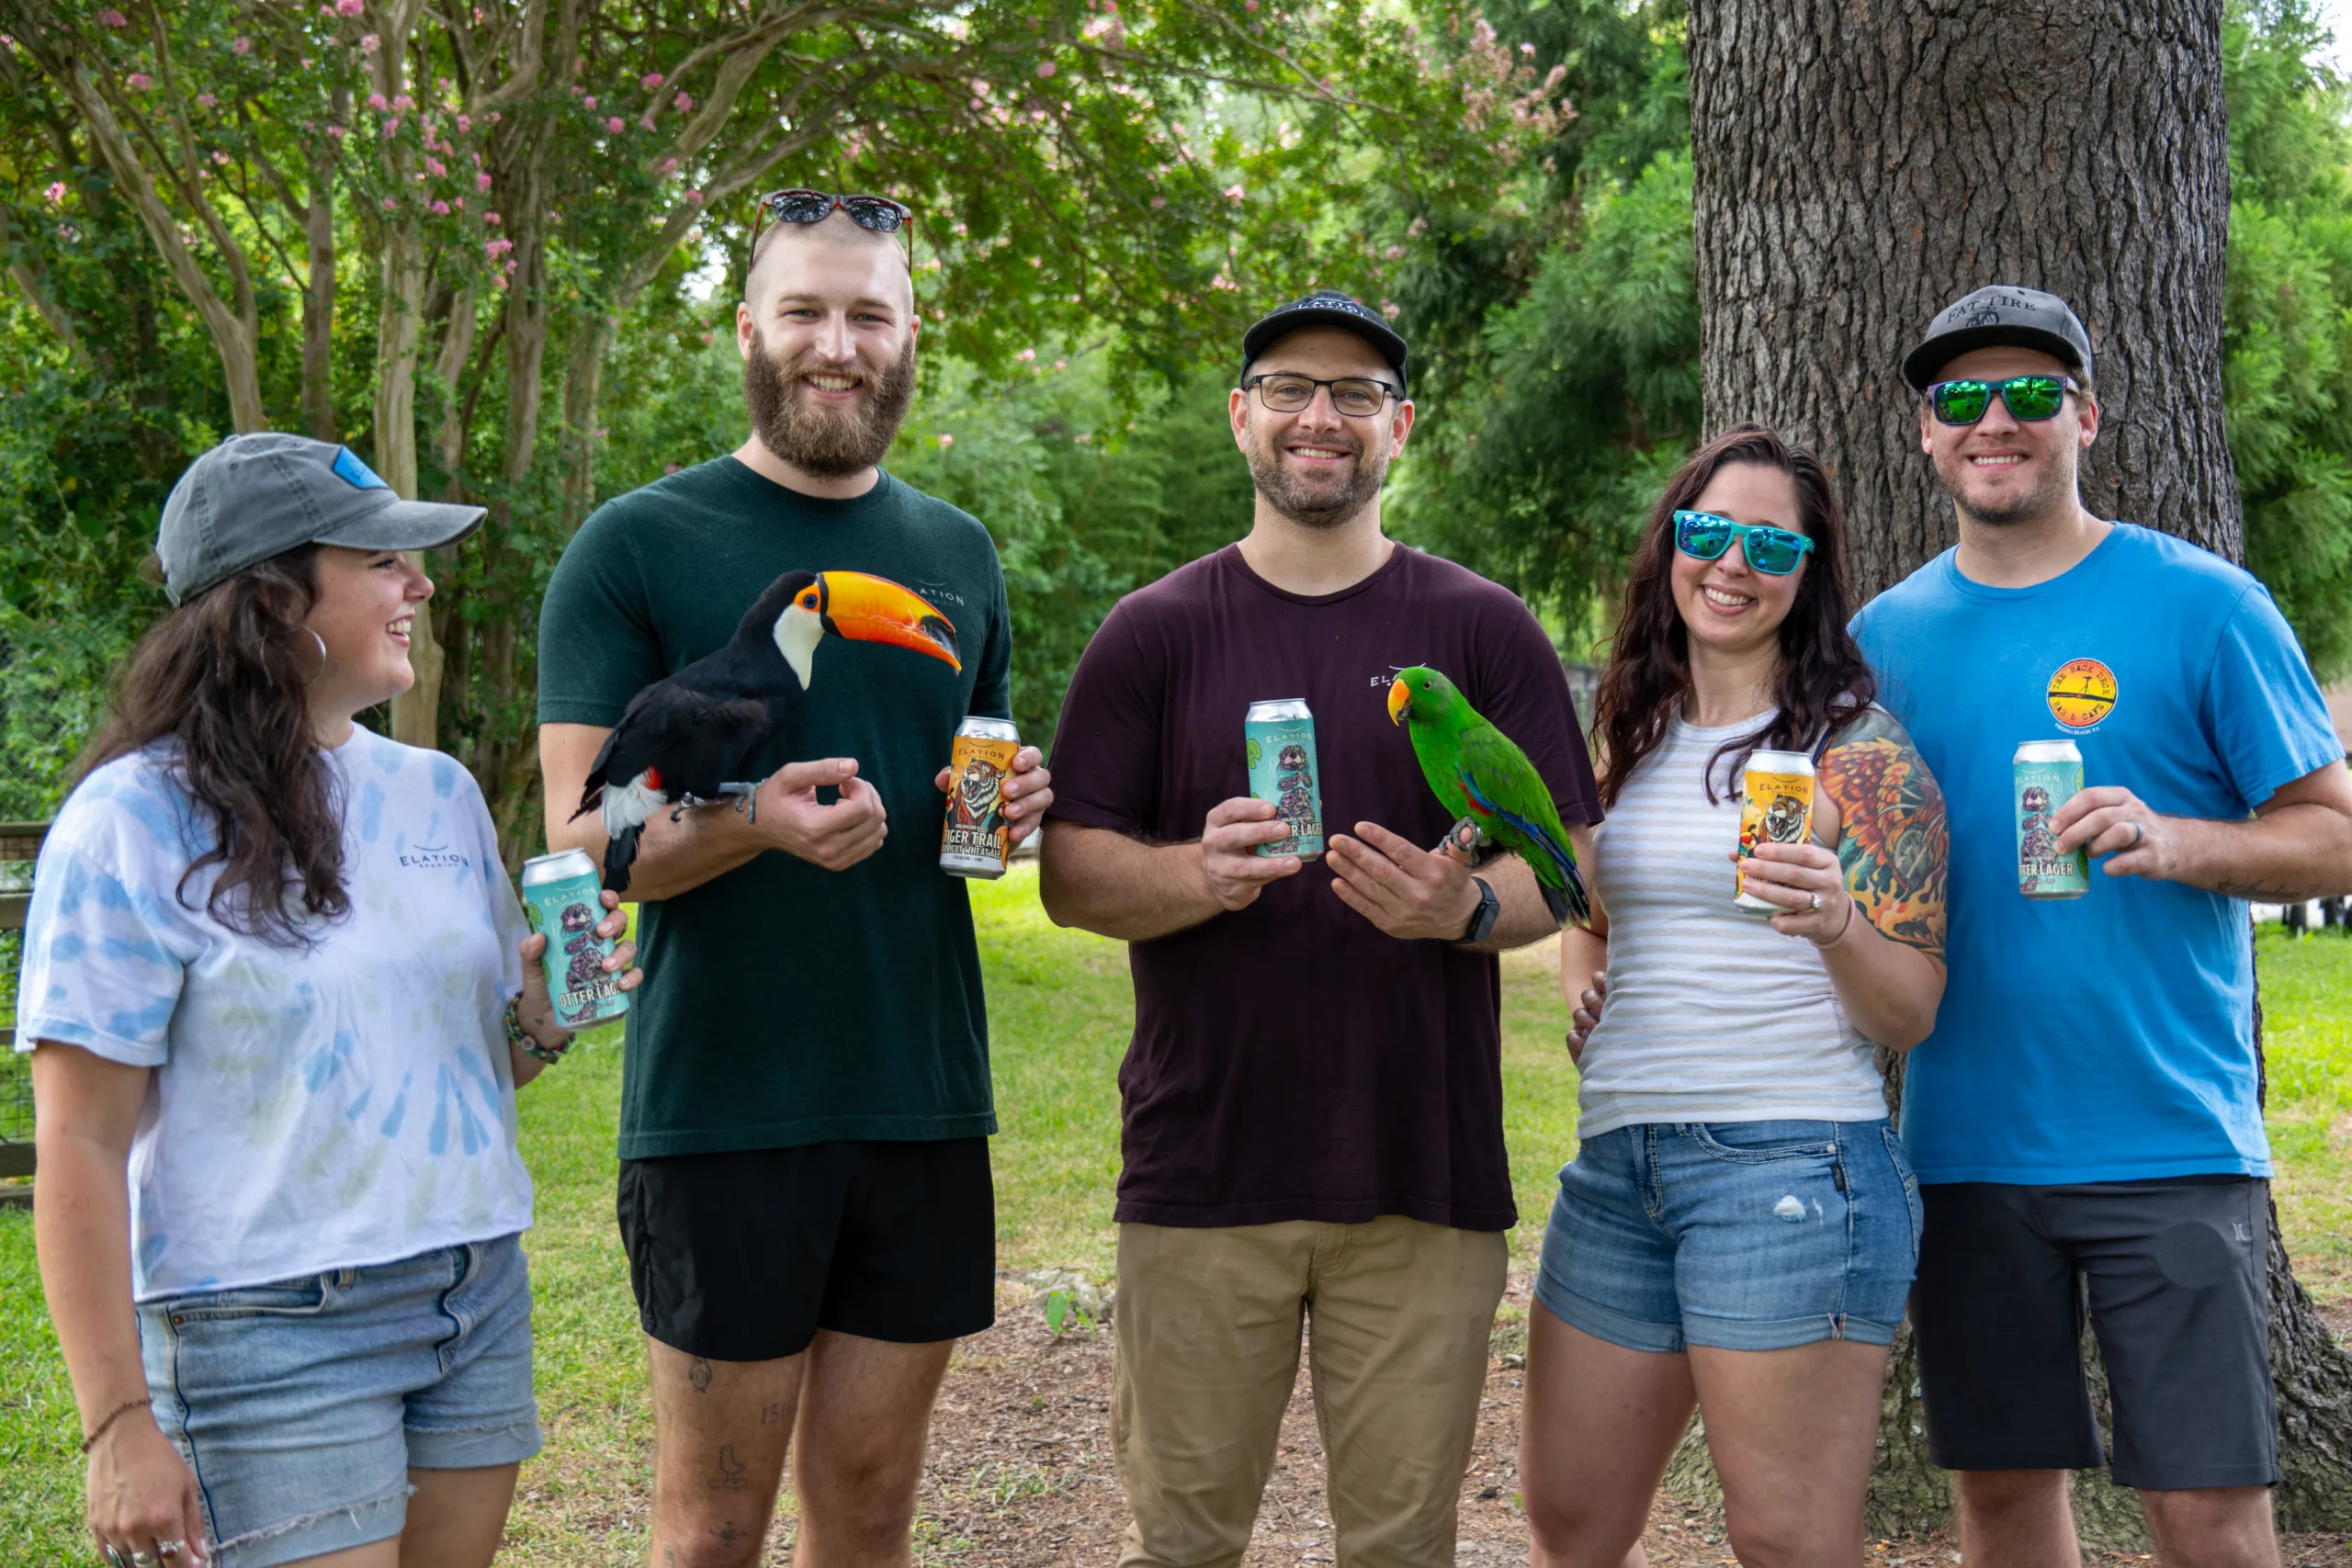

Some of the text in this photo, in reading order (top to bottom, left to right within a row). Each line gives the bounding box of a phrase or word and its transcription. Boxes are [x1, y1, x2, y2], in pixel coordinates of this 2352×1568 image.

[1947, 295, 2036, 324] FAT TIRE
[920, 588, 964, 606] ATION
[2053, 664, 2110, 695] THE BACK DECK
[2053, 700, 2067, 717] BAR
[1266, 732, 1312, 743] ELATION
[958, 748, 1005, 761] ELATION
[1759, 783, 1808, 795] ELATION
[944, 829, 1001, 849] TIGER TRAIL
[399, 854, 469, 868] ELATION
[964, 845, 989, 857] WHEAT
[989, 849, 1001, 860] ALE
[2018, 862, 2074, 876] TTER LAGER
[544, 885, 598, 908] ELATION
[560, 988, 595, 1009] OTTER
[595, 980, 619, 999] LAG
